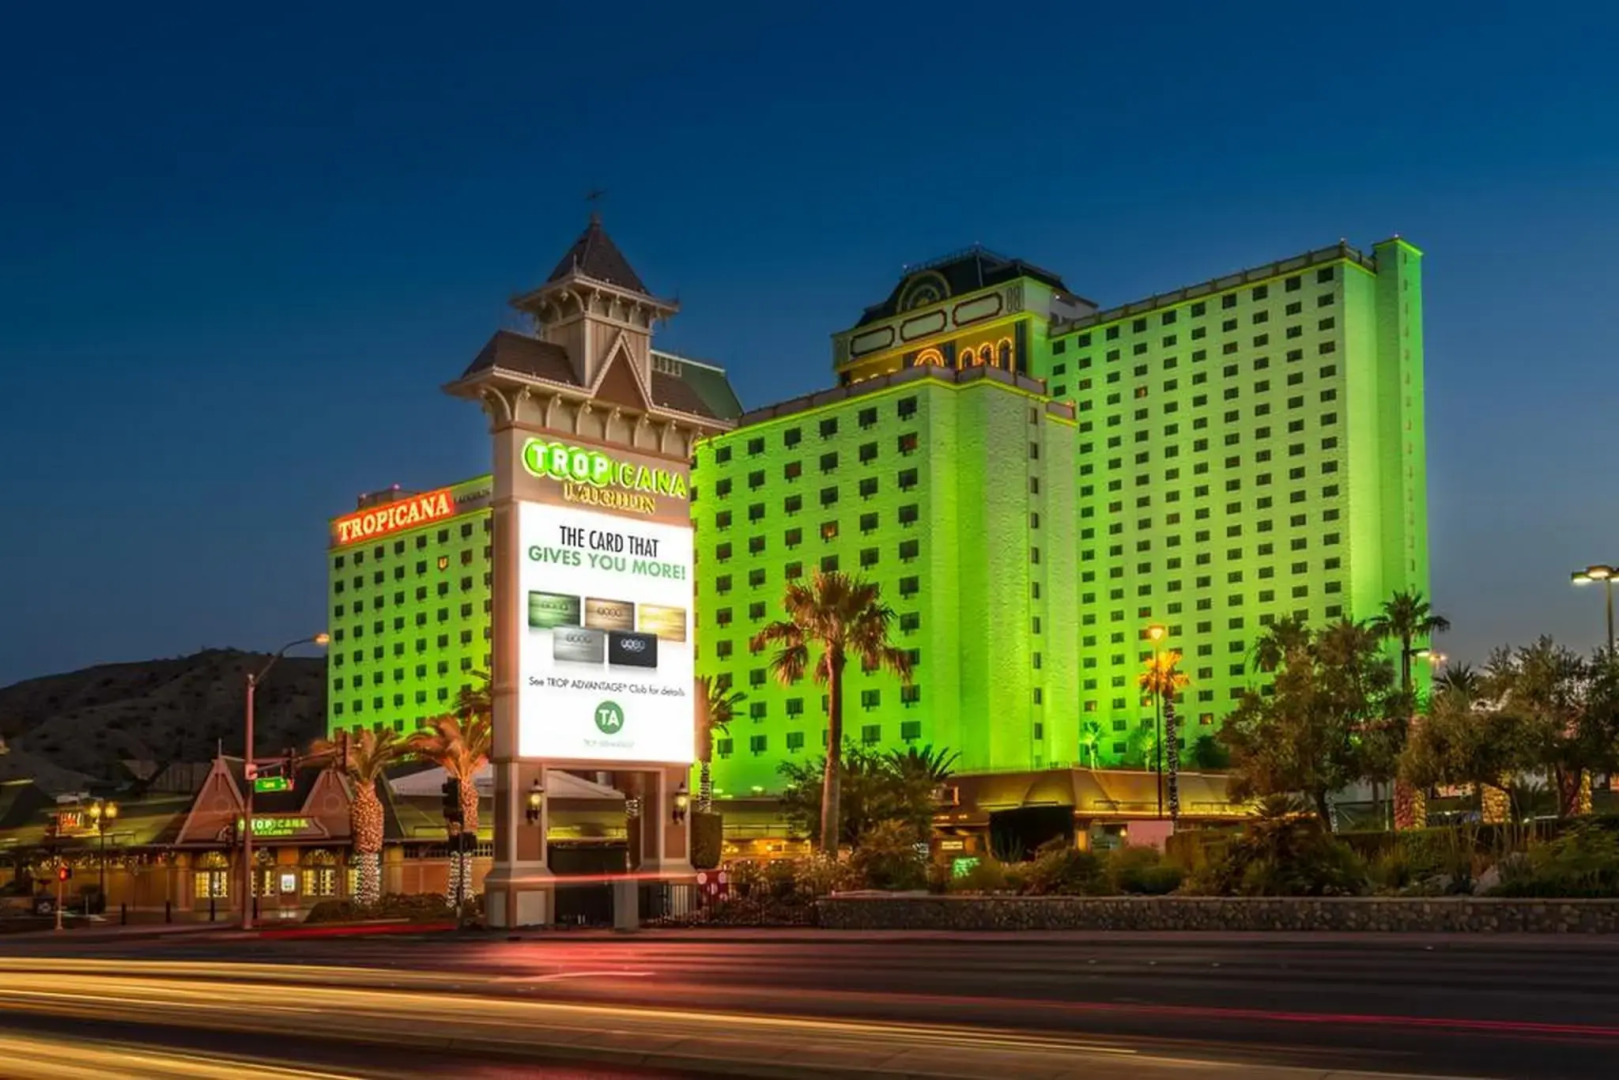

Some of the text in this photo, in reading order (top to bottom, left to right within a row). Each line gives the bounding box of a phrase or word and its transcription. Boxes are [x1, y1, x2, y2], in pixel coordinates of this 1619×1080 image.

[525, 440, 688, 499] TROPICANA
[338, 493, 450, 542] TROPICANA
[559, 525, 659, 558] THE CARD THAT
[528, 545, 686, 580] GIVES YOU MORE!
[528, 676, 545, 687] See
[547, 677, 569, 688] TROP
[629, 684, 647, 695] Club
[649, 686, 659, 695] for
[598, 708, 620, 727] TA
